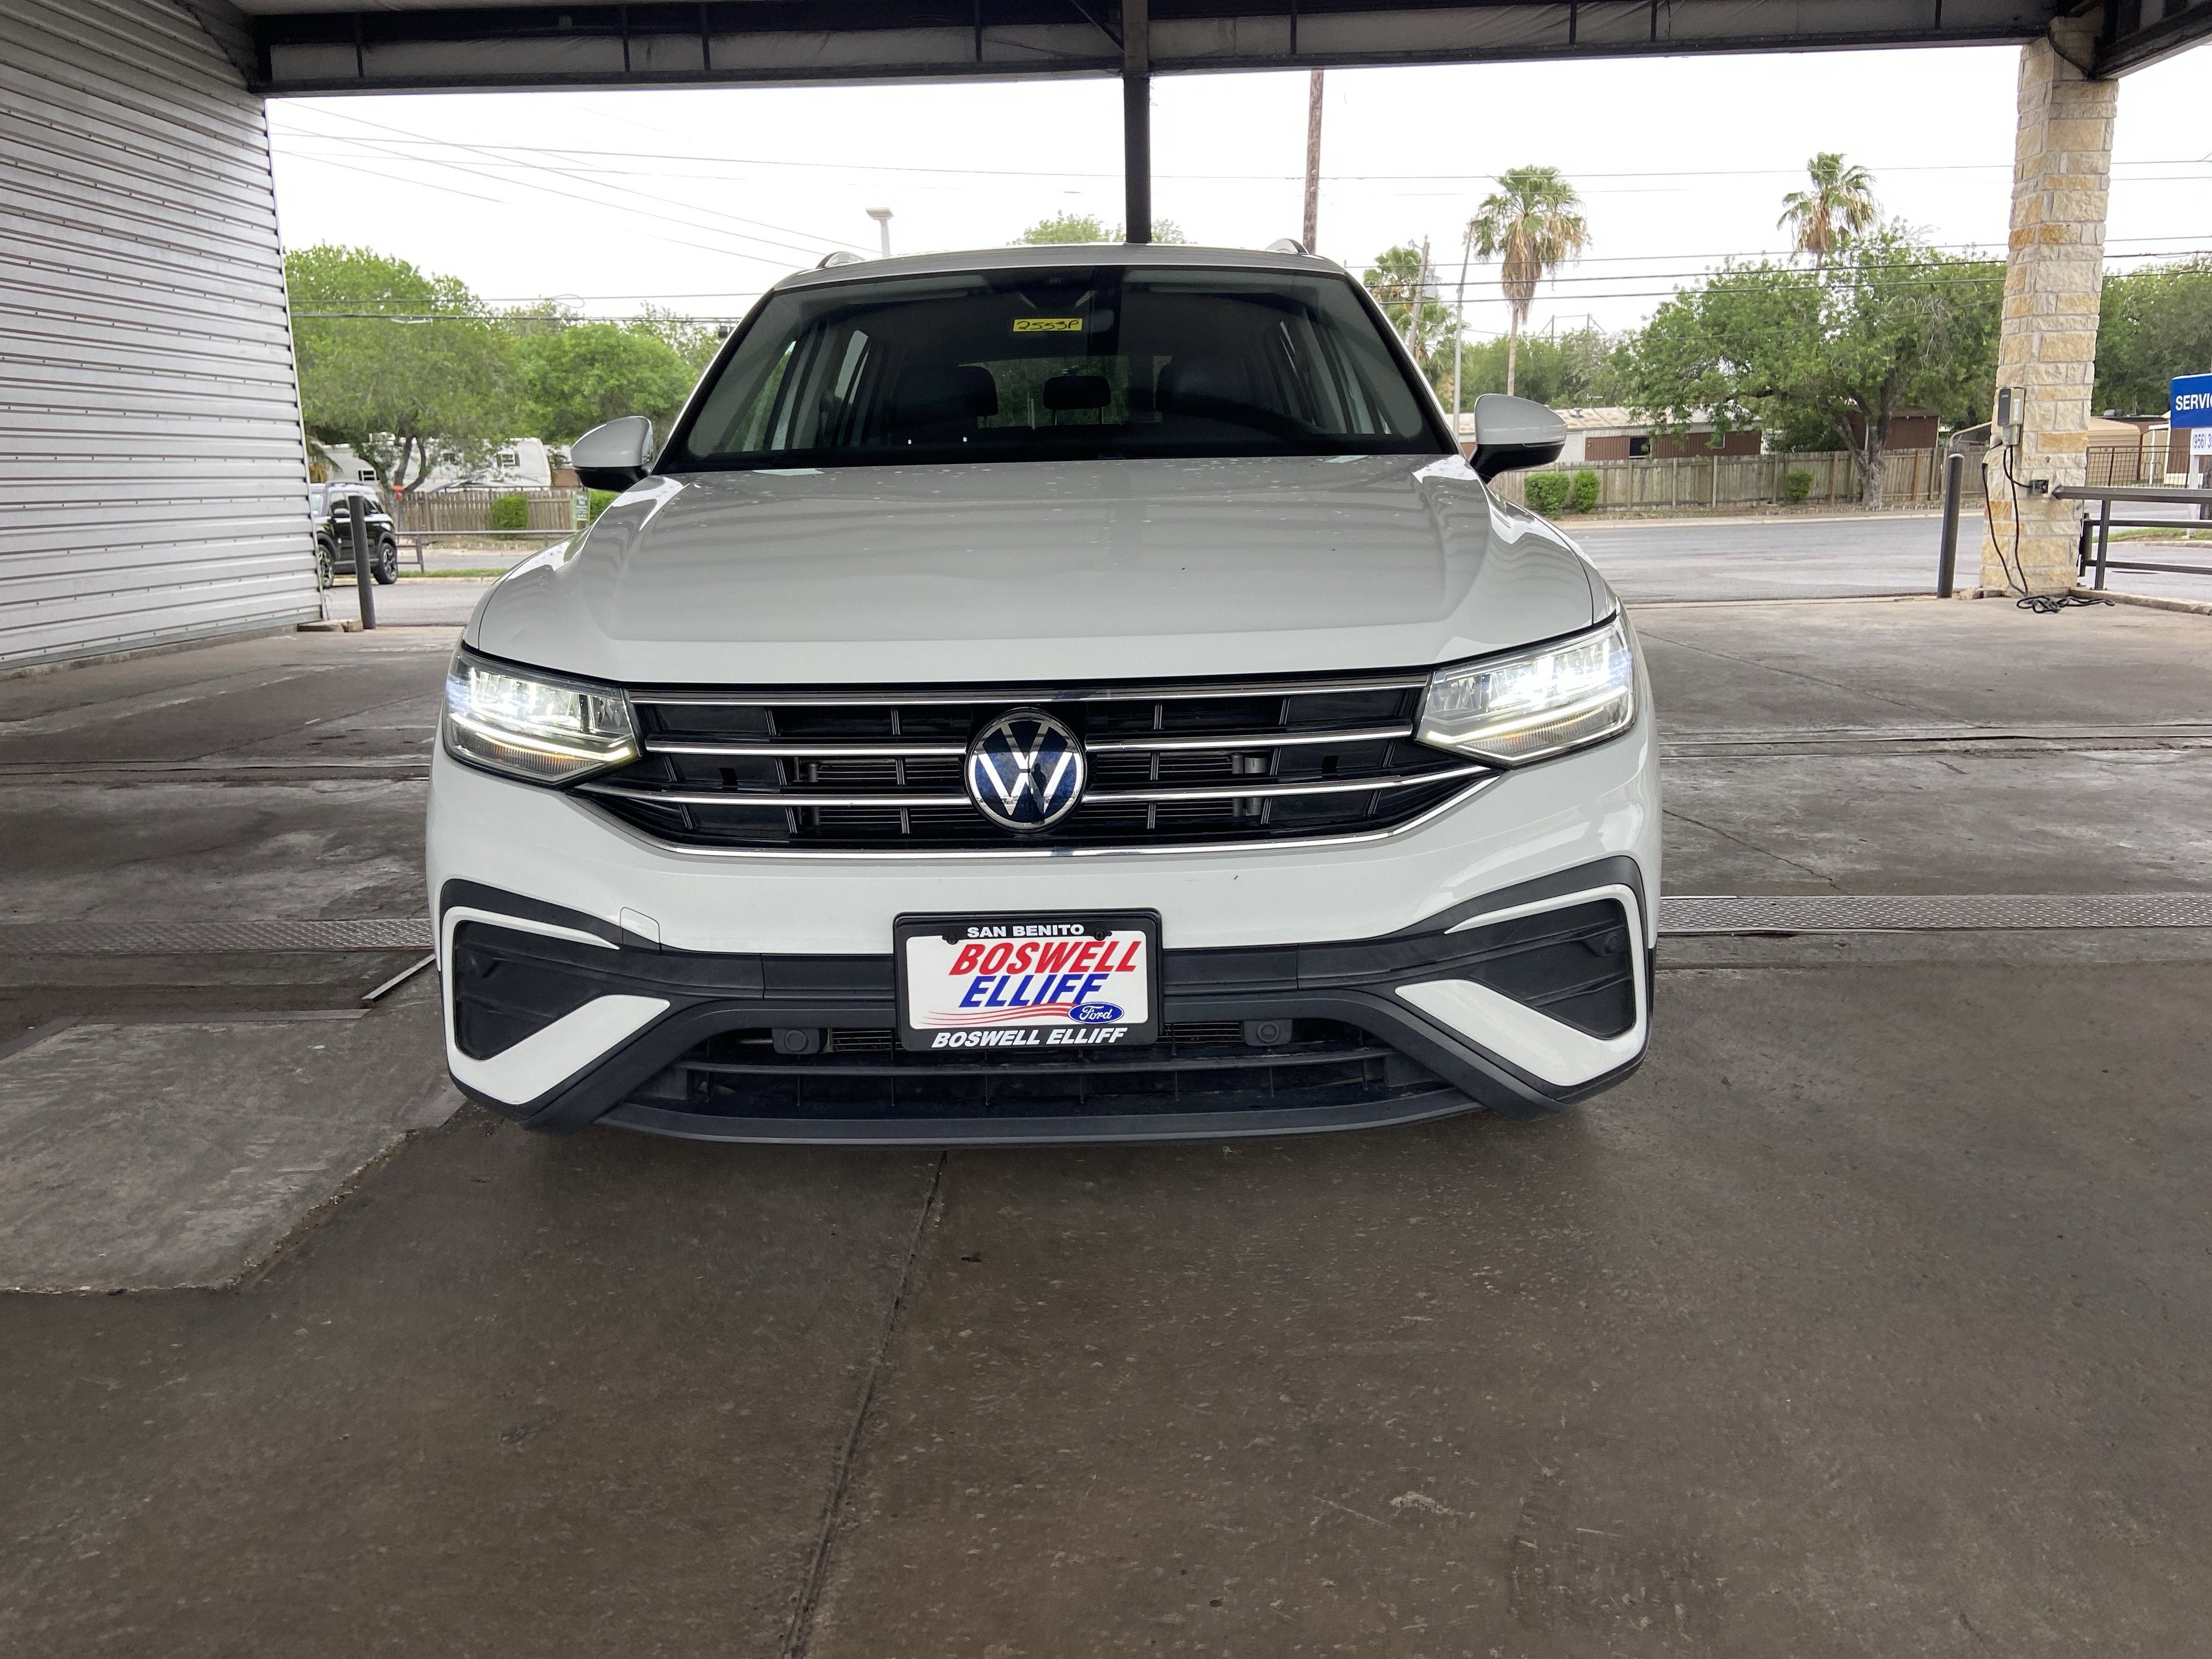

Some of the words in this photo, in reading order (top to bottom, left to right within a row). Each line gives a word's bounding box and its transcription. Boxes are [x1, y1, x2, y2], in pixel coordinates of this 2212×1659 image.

[2192, 433, 2207, 449] (956)
[2208, 433, 2212, 448] 3
[974, 719, 1076, 817] VW
[967, 926, 1007, 938] SAN
[1012, 924, 1084, 936] BENITO
[949, 941, 1142, 976] BOSWELL
[958, 973, 1110, 1008] ELLIFF
[1079, 1006, 1113, 1020] Ford
[932, 1029, 1041, 1048] BOSWELL
[1046, 1027, 1128, 1045] ELLIFF
